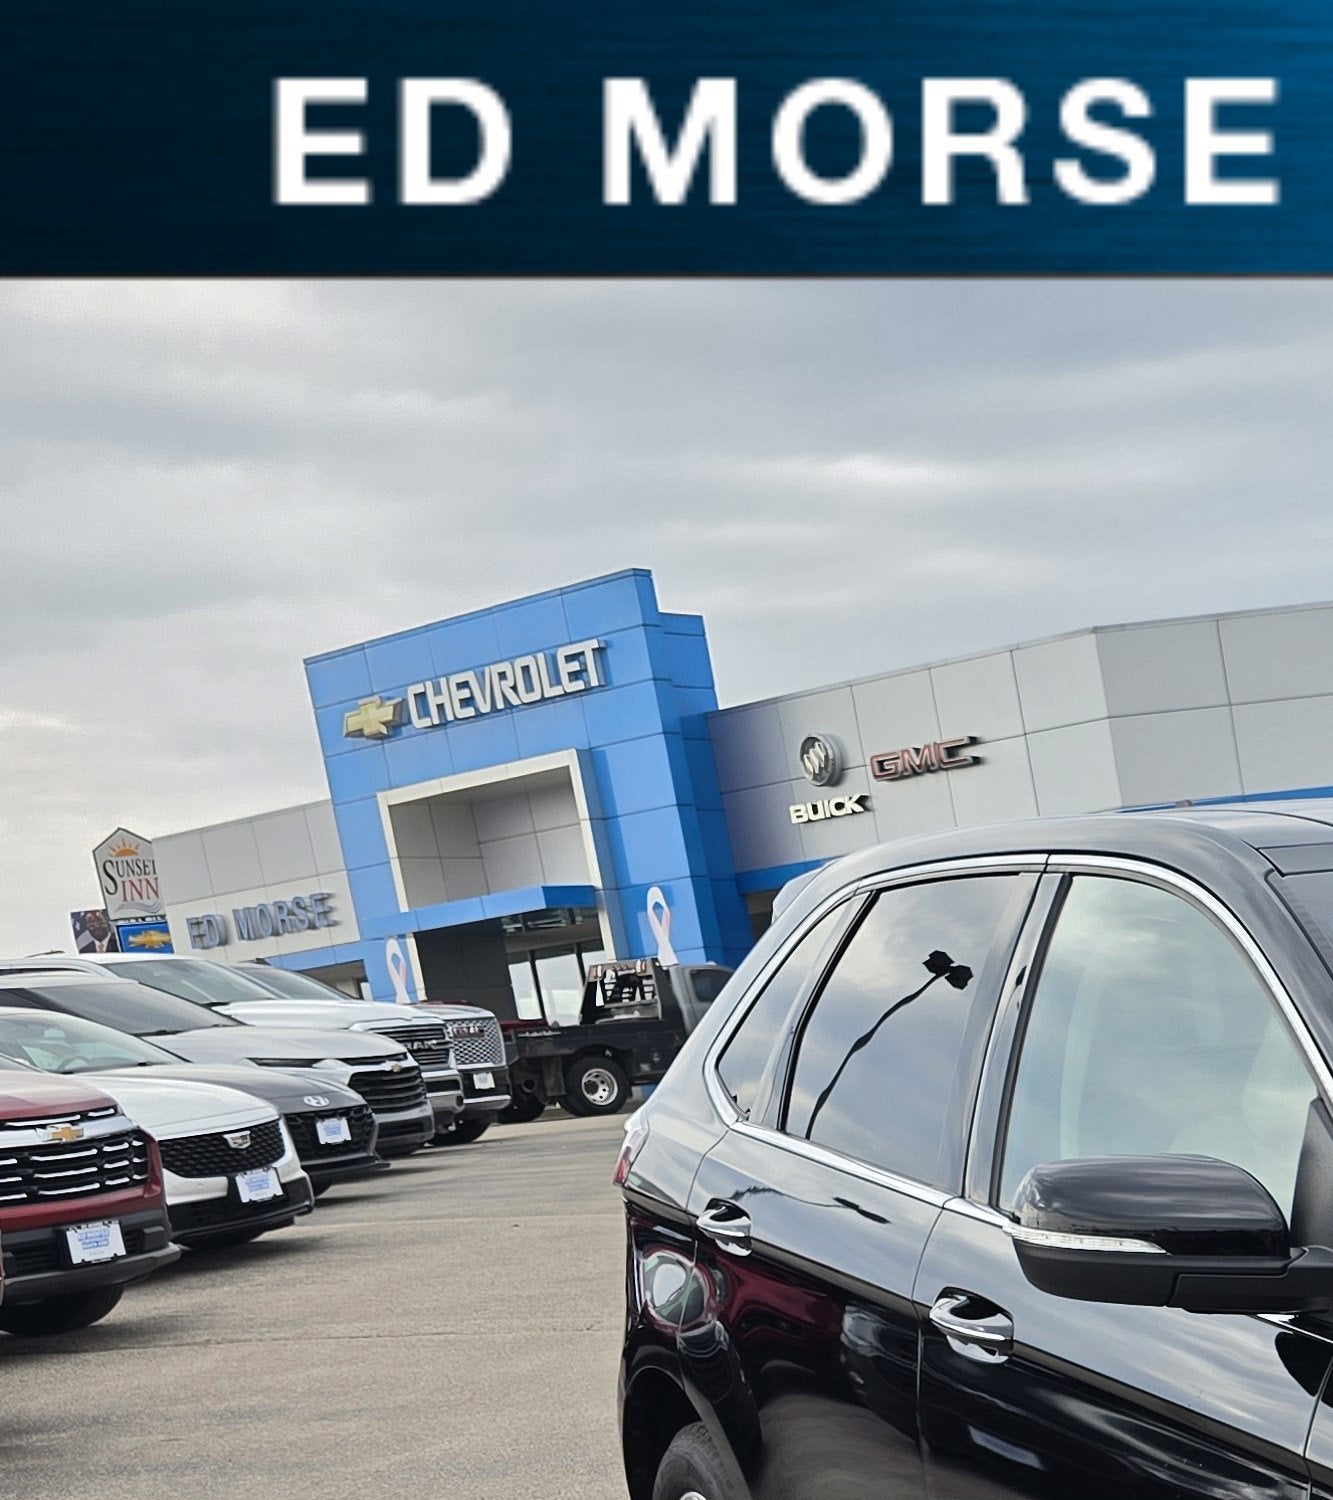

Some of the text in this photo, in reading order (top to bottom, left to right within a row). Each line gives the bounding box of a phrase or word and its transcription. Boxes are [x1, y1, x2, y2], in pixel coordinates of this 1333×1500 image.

[407, 638, 604, 729] CHEVROLET
[869, 736, 976, 782] GMC
[789, 793, 865, 824] BUICK
[121, 877, 160, 902] INN
[186, 893, 337, 950] ED MORSE
